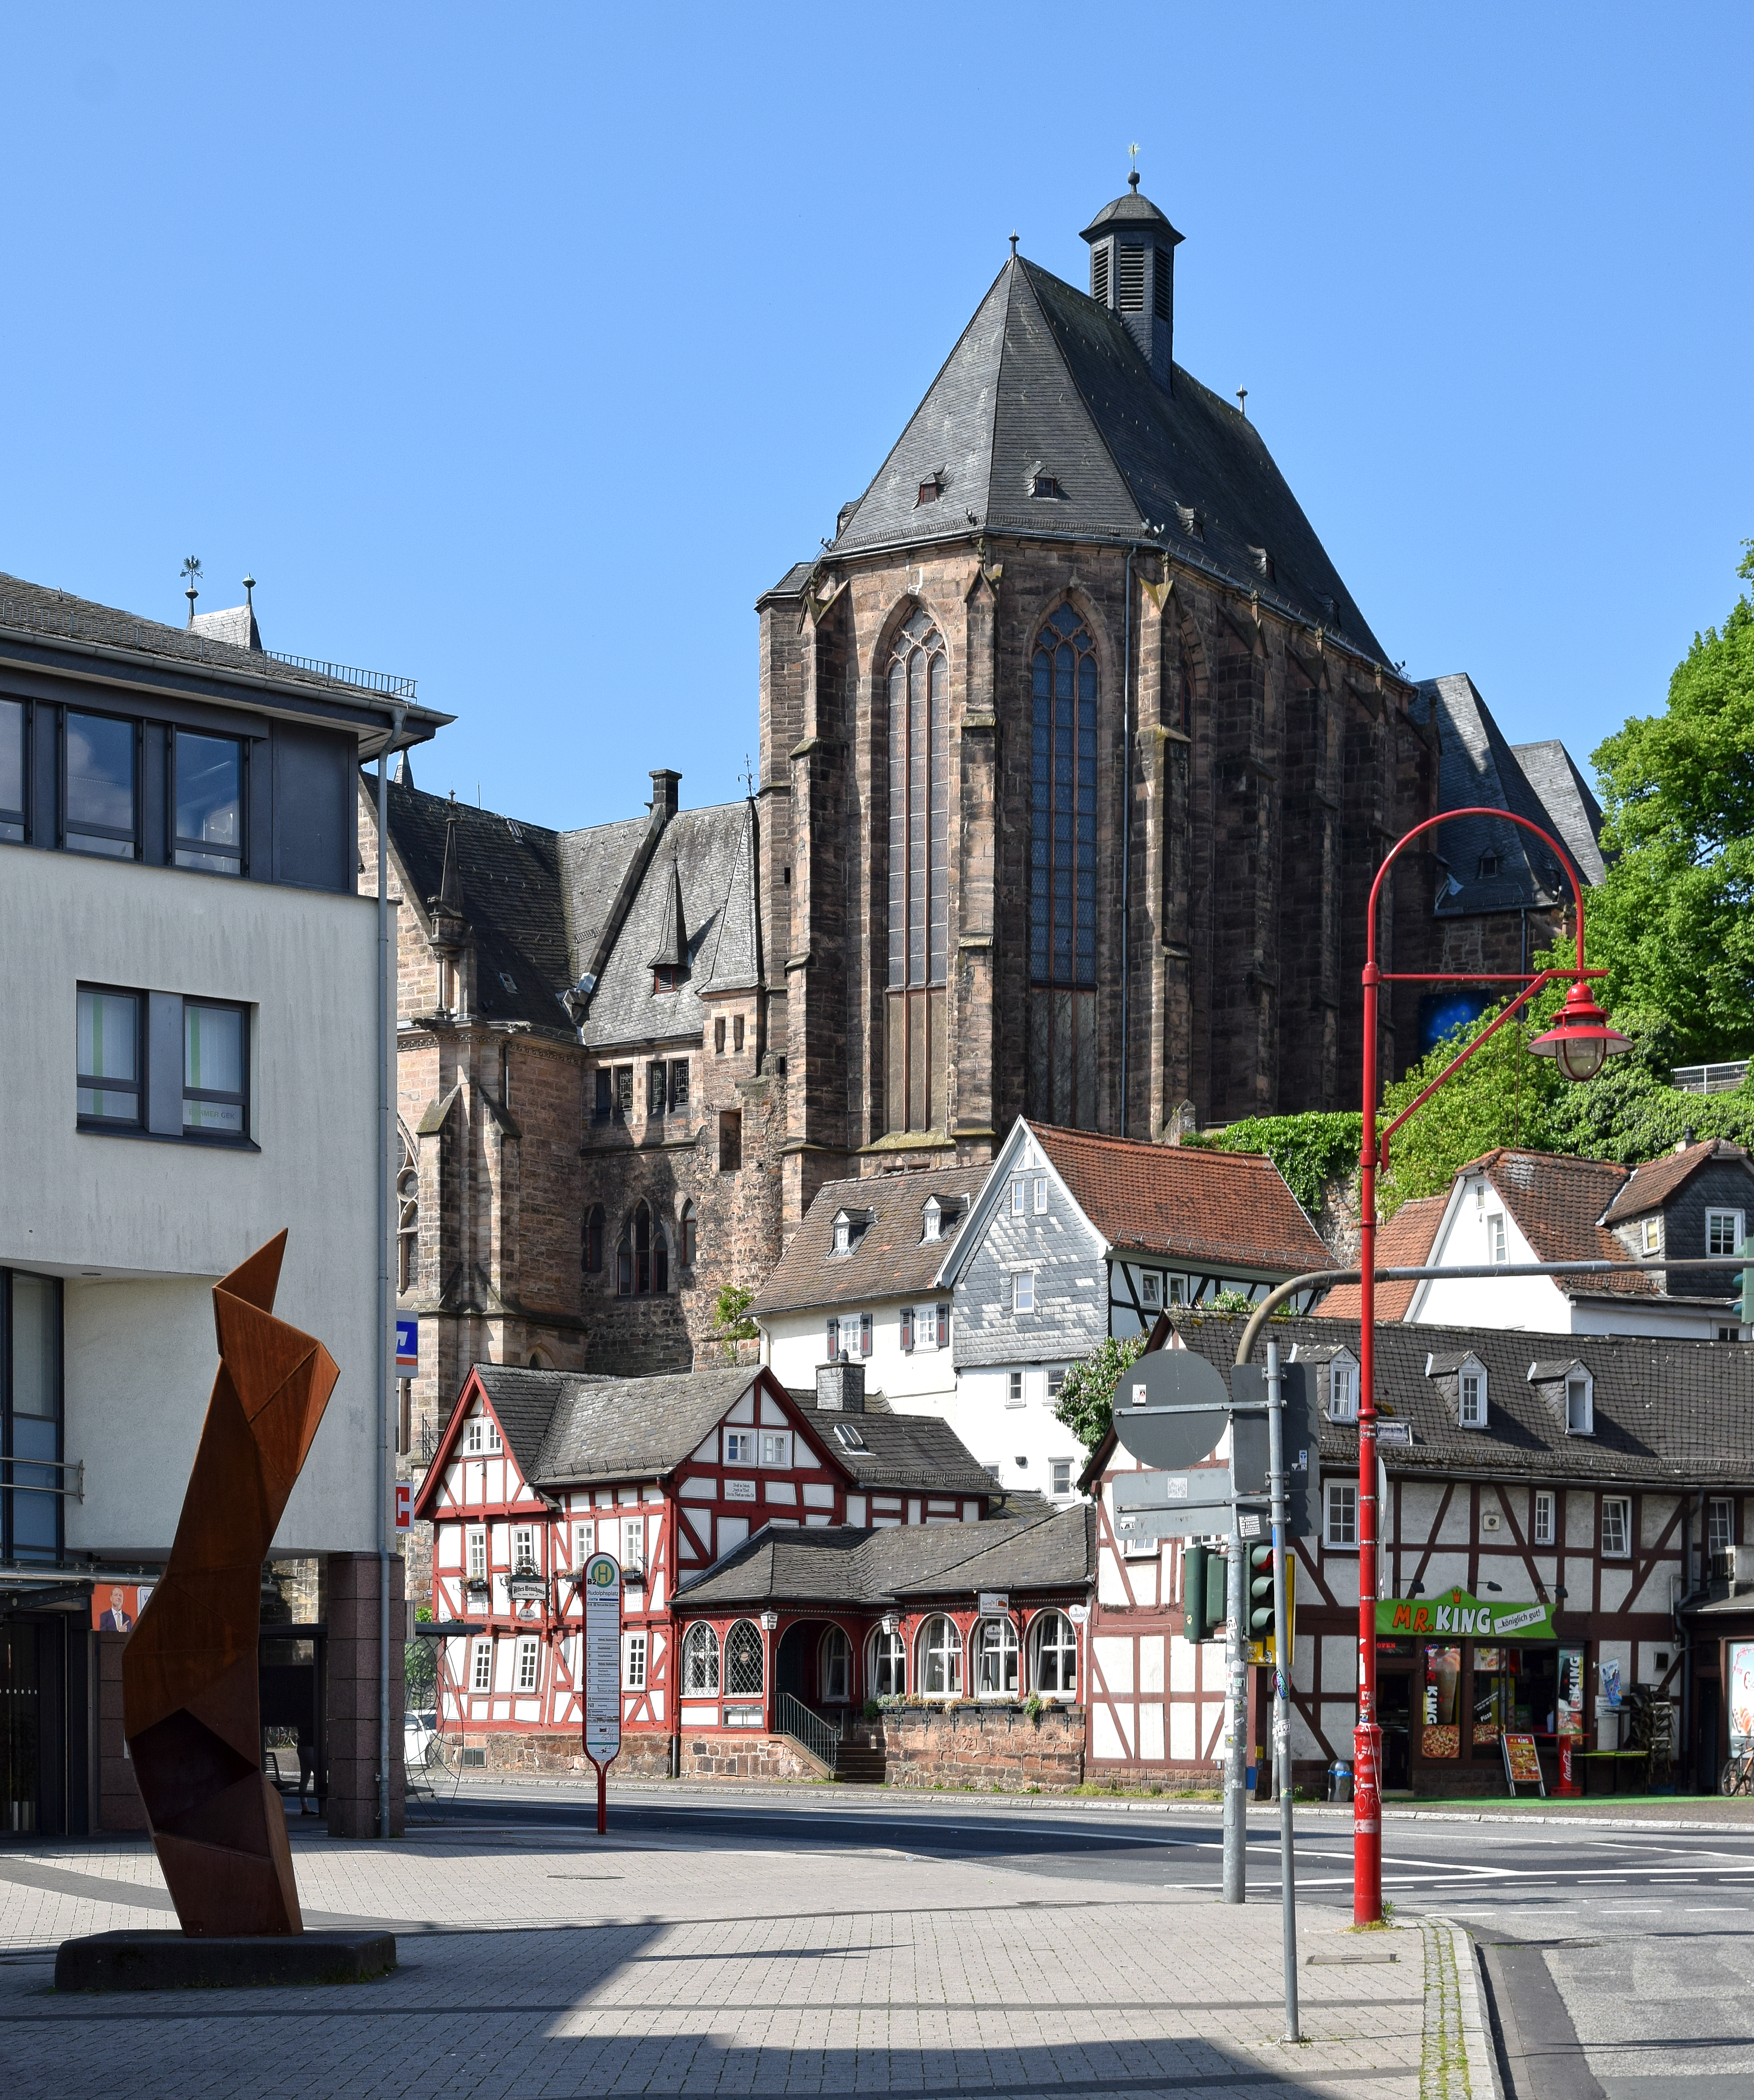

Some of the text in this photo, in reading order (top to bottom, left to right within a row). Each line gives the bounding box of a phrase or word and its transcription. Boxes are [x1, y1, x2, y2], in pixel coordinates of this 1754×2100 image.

[598, 1566, 608, 1581] H
[513, 1585, 545, 1595] Altes Brauhaus
[1392, 1604, 1491, 1634] MR. KING
[1497, 1608, 1541, 1629] ...königlich gut!
[1569, 1655, 1580, 1694] KING
[1427, 1686, 1438, 1725] KING
[1480, 1712, 1492, 1722] Pizza
